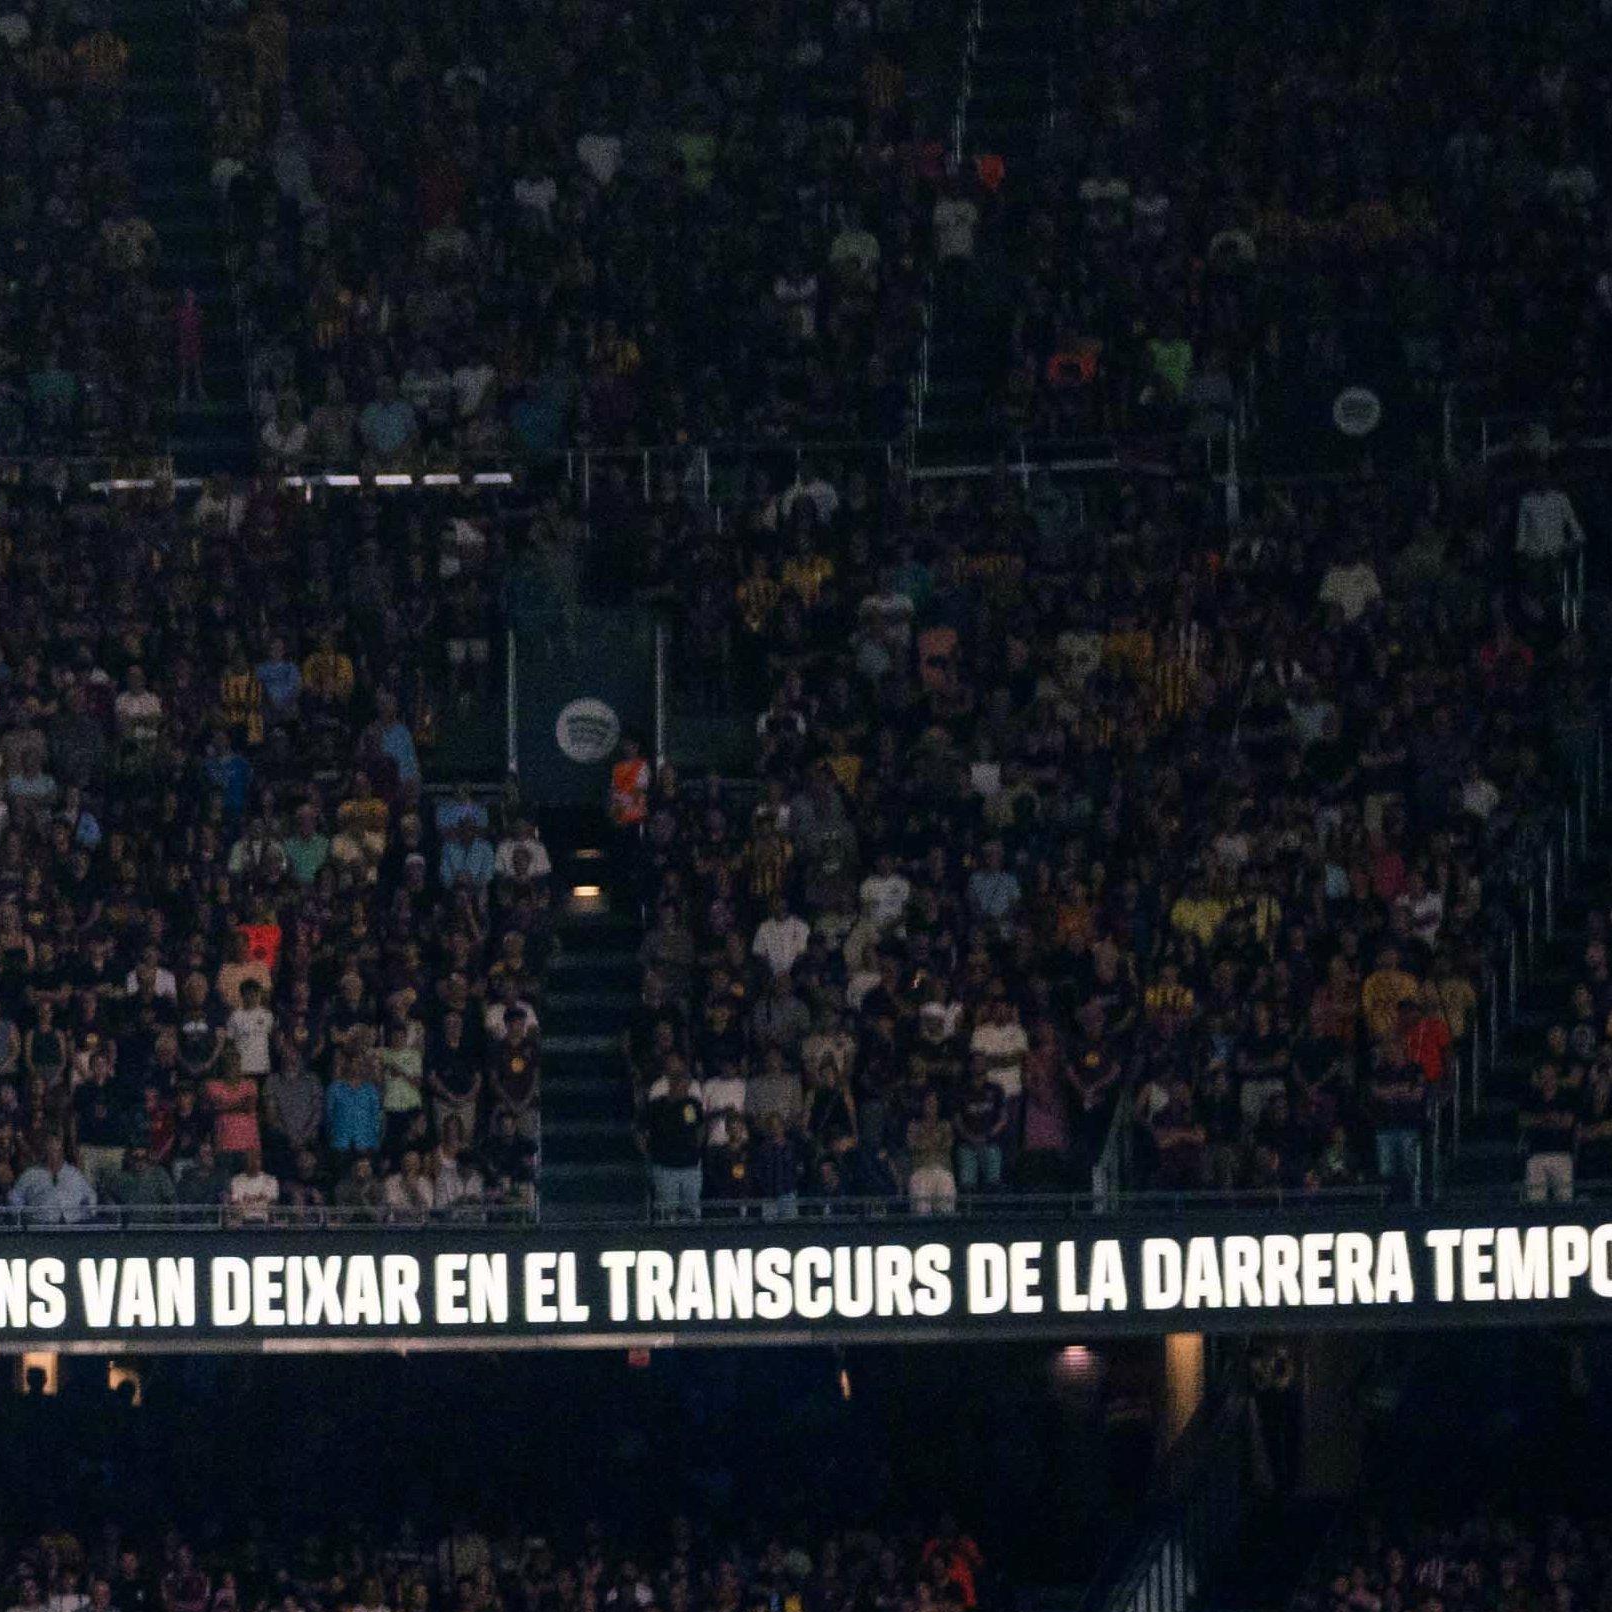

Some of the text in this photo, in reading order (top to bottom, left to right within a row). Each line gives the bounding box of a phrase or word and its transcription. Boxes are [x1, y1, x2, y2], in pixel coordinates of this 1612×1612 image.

[78, 1256, 196, 1328] VAN
[210, 1254, 422, 1327] DEIXAR
[434, 1252, 509, 1324] EN
[524, 1251, 590, 1323] EL
[599, 1243, 952, 1322] TRANSCURS
[966, 1241, 1044, 1315] DE
[1057, 1239, 1128, 1312] LA
[1141, 1230, 1414, 1310] DARRERA
